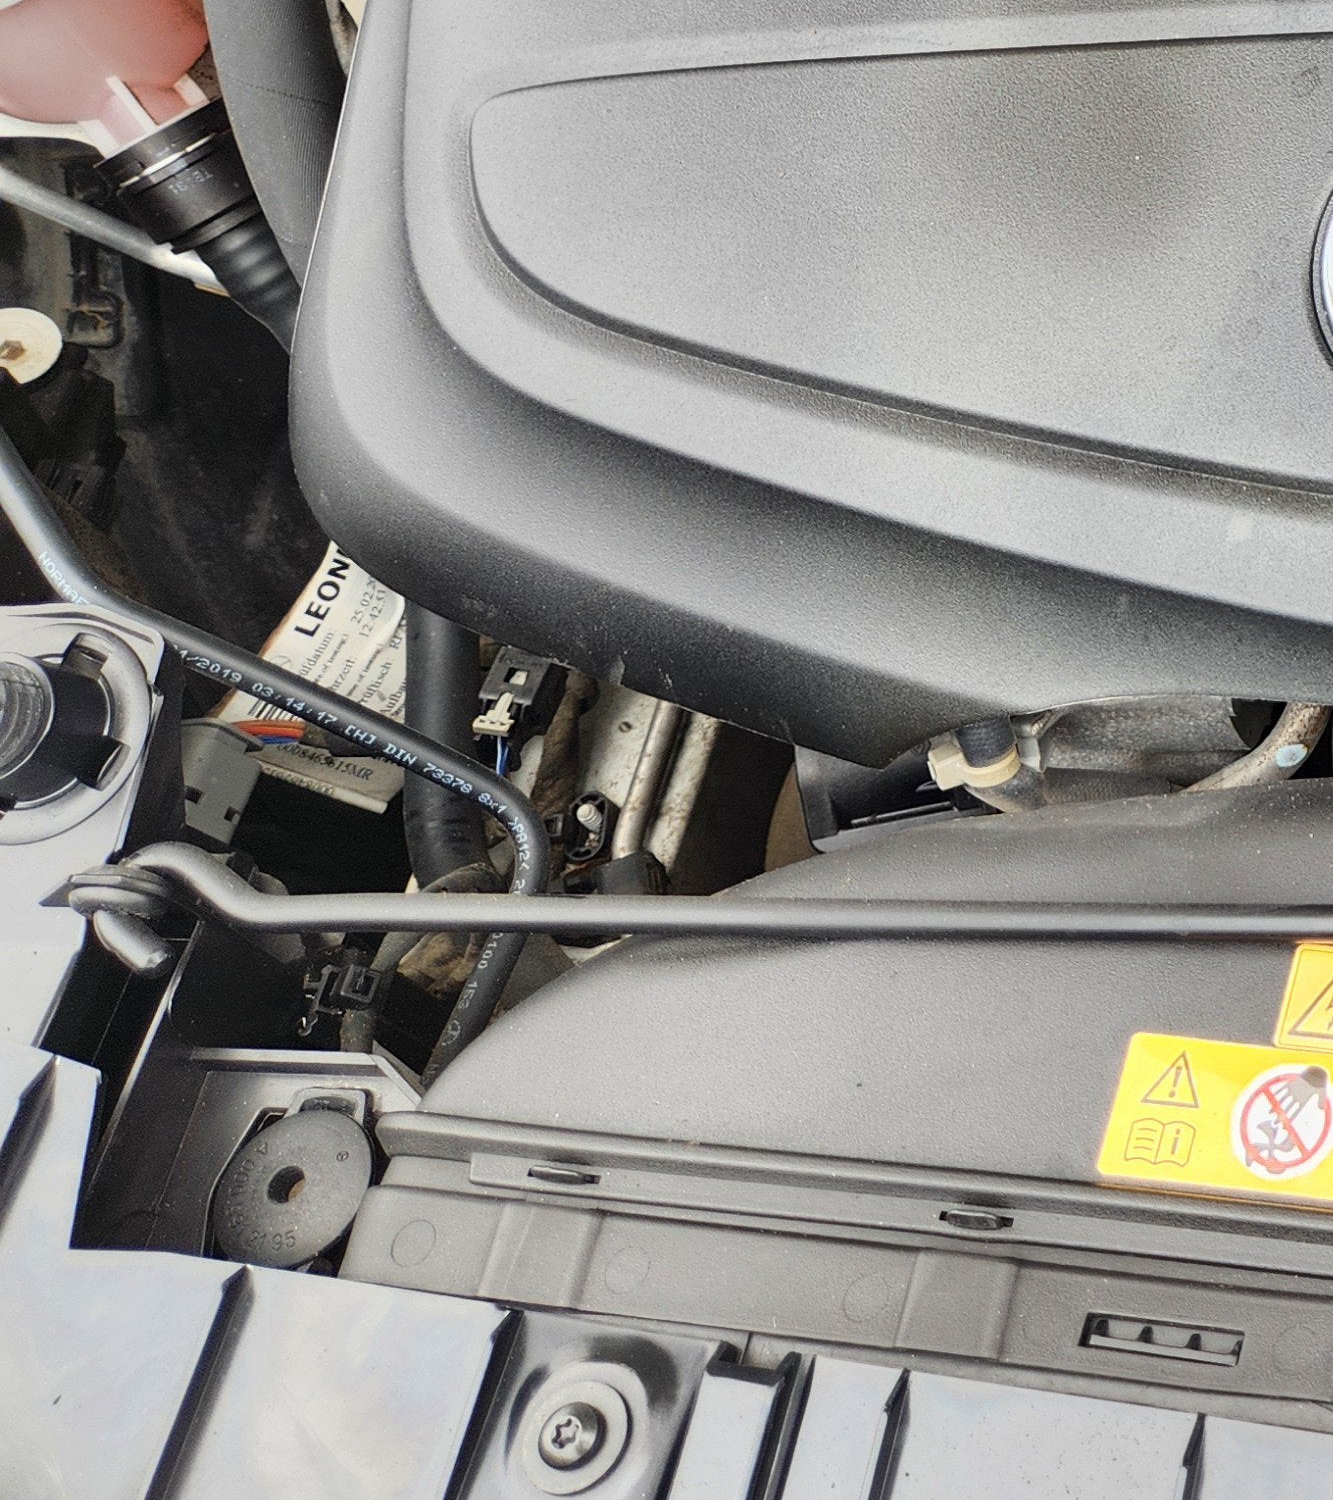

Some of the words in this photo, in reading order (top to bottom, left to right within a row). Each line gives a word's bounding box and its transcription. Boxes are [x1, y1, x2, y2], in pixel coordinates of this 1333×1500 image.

[172, 644, 243, 684] 1/2019
[252, 682, 338, 725] 03:14:17
[383, 743, 418, 766] DIN
[422, 763, 474, 795] 73378
[272, 1230, 296, 1252] 95
